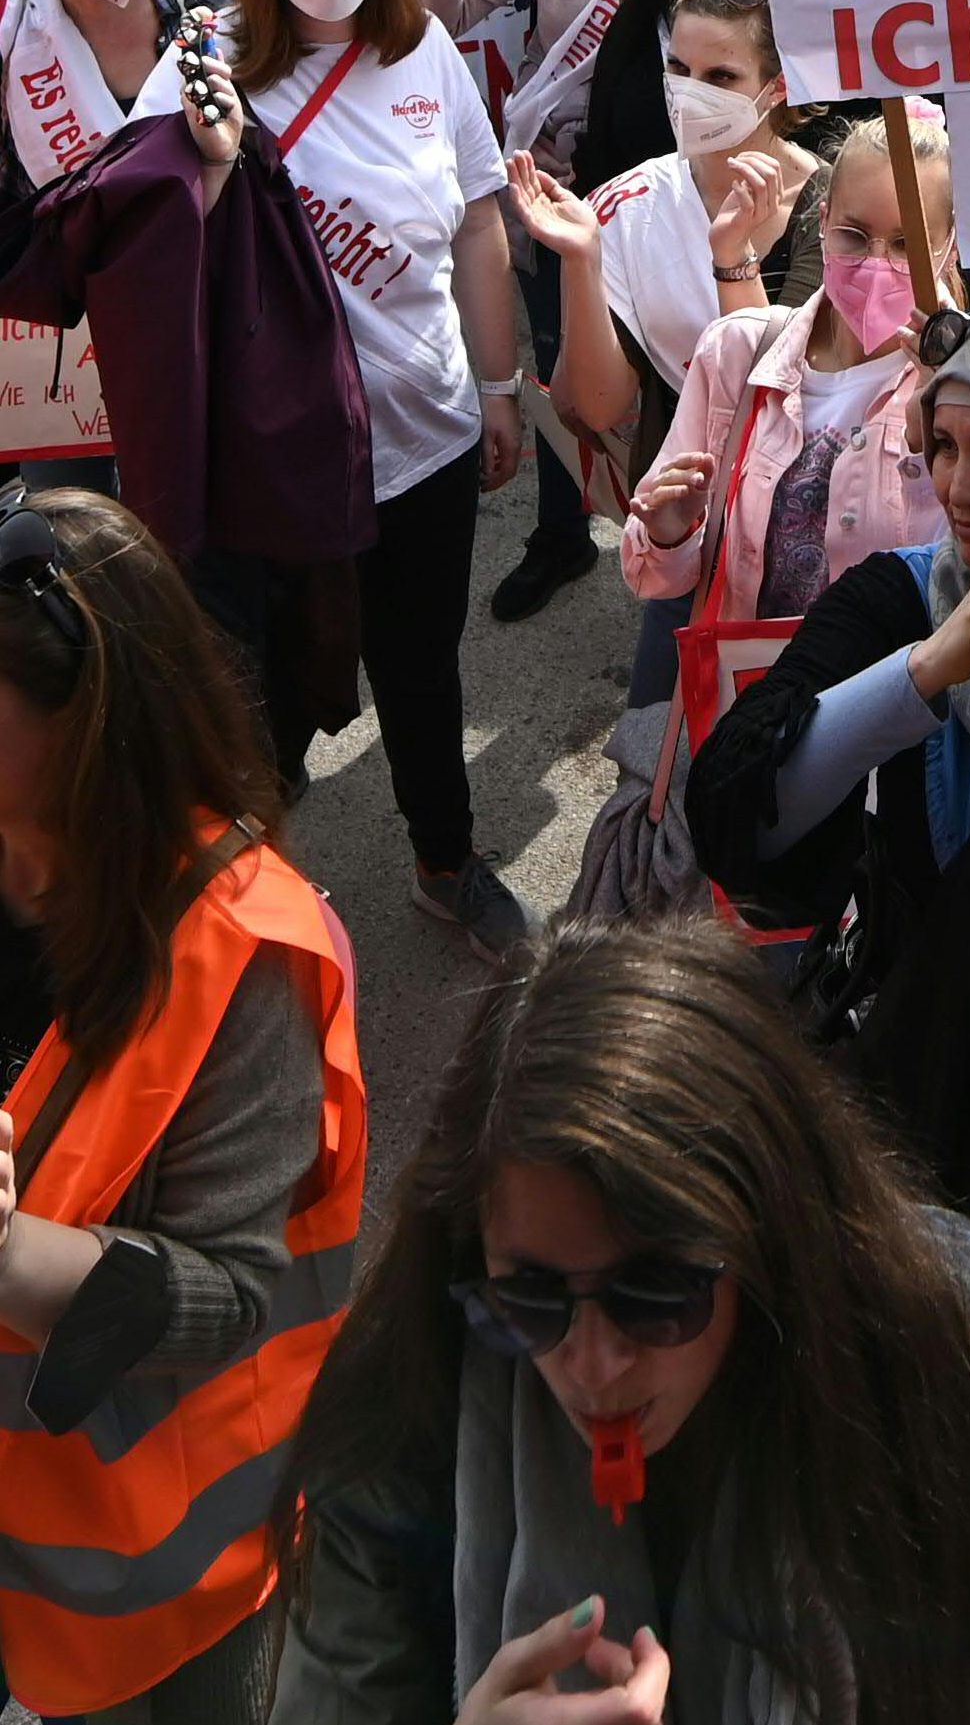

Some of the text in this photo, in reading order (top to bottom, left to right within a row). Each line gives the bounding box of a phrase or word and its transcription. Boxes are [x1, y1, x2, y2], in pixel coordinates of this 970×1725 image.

[20, 56, 67, 111] Es
[391, 99, 441, 117] Hard Rock
